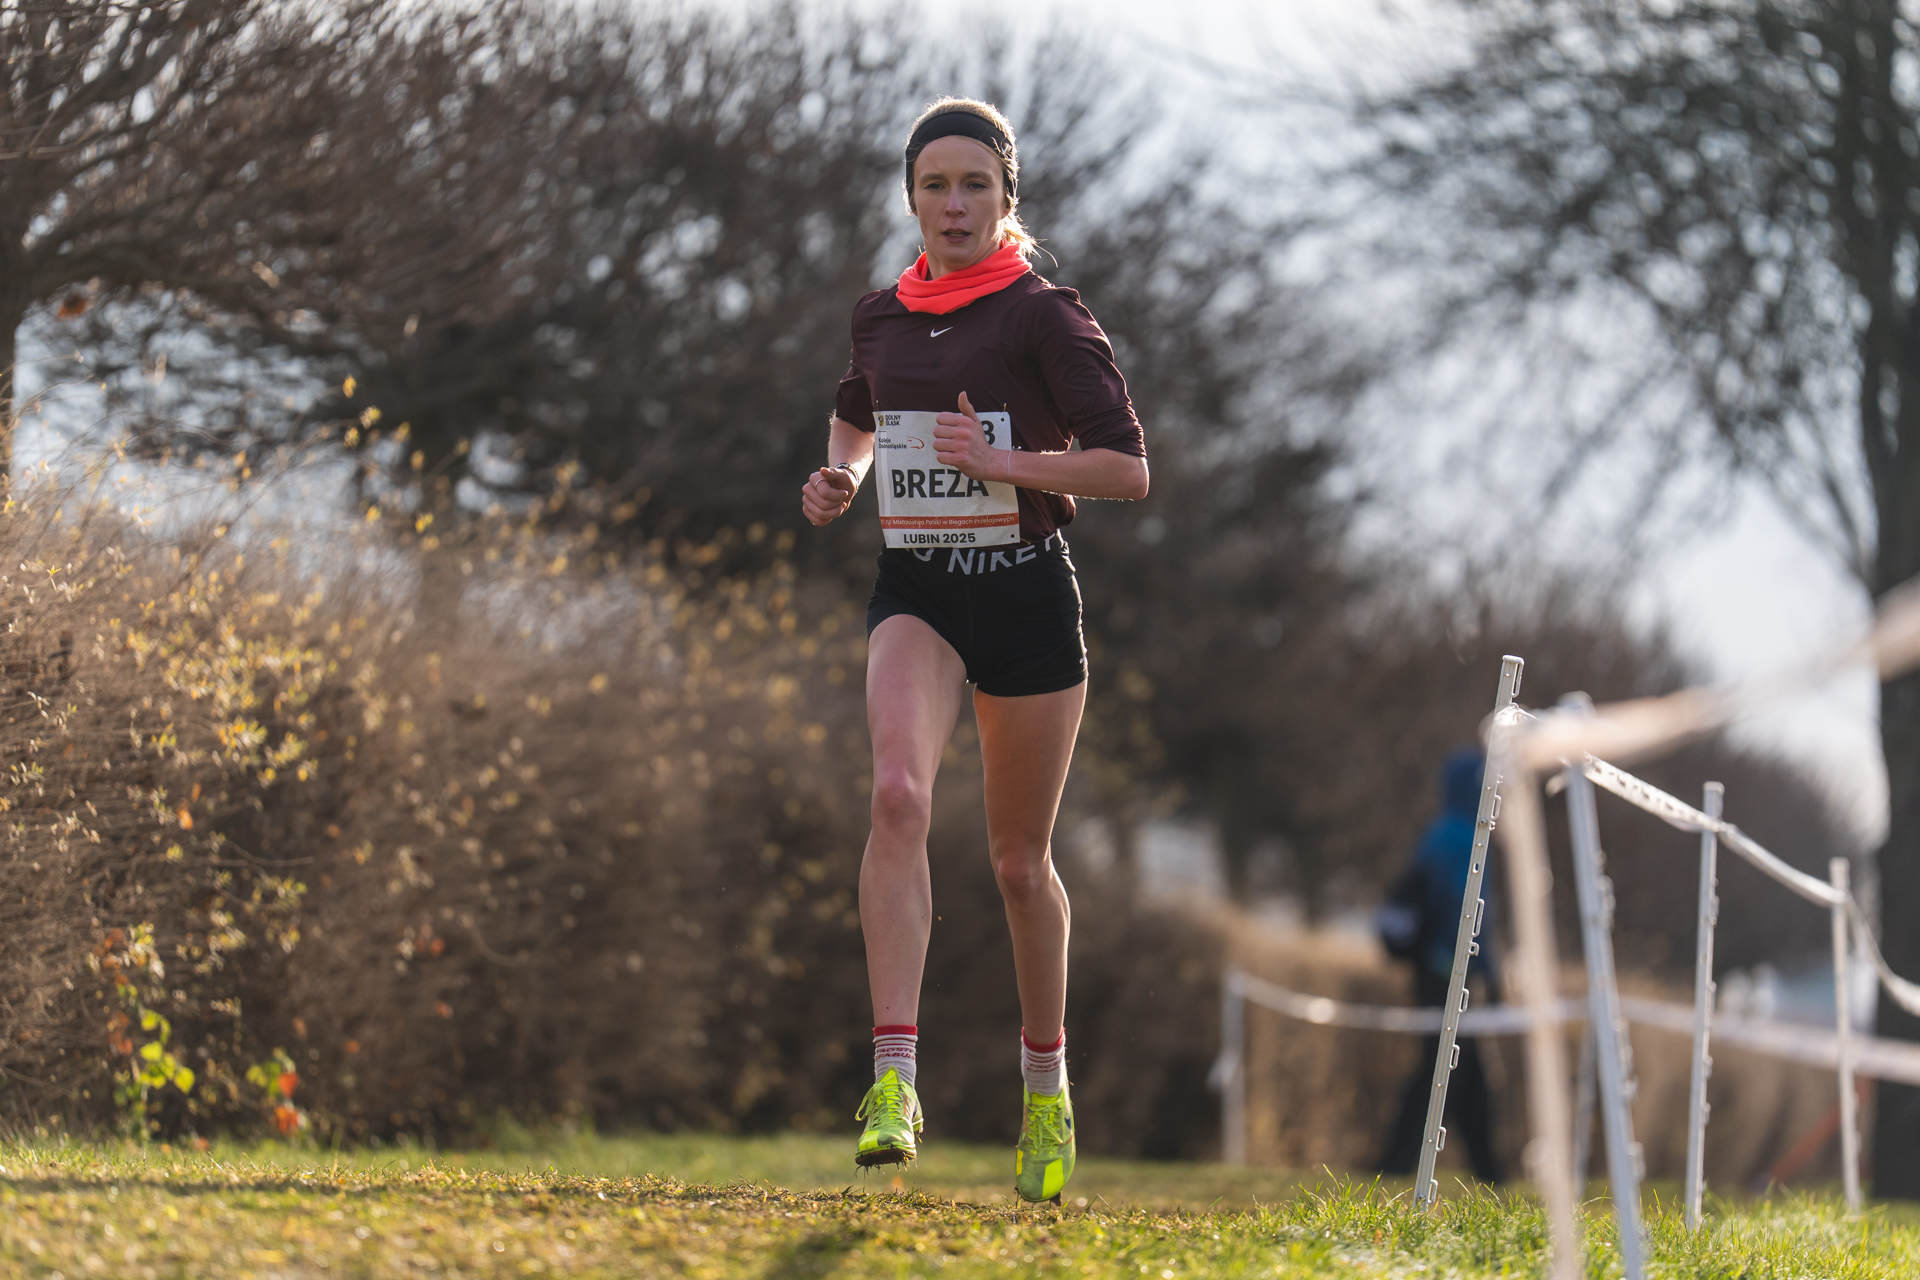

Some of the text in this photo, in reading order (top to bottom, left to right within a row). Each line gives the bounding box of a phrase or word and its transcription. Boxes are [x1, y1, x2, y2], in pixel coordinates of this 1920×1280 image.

[891, 468, 989, 499] BREZA
[948, 518, 974, 526] Biegach
[903, 532, 976, 544] LUBIN 2025
